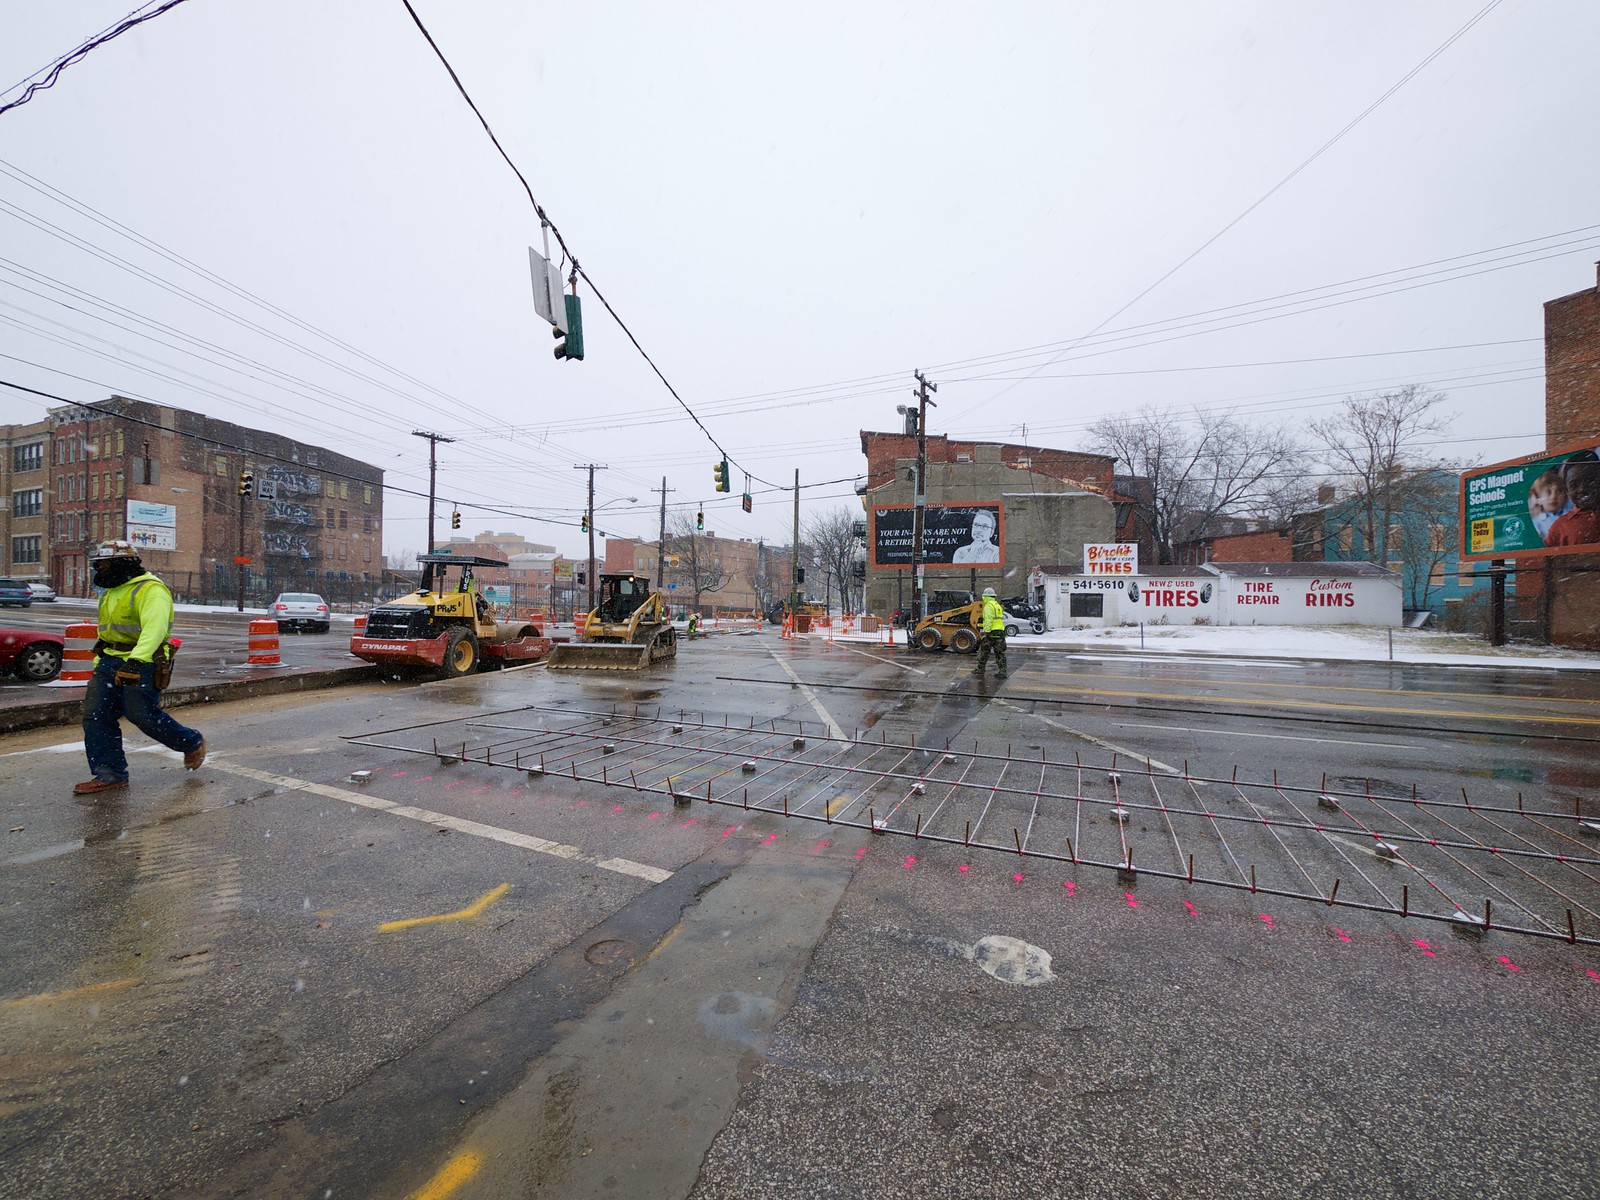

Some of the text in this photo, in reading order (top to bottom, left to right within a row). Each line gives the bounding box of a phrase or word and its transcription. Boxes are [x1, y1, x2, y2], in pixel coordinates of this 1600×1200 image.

[1469, 470, 1524, 492] CPS Magnet
[1469, 488, 1506, 505] Schools
[1473, 521, 1488, 529] Apply
[880, 529, 900, 537] YOUR
[901, 528, 932, 536] IN-WS
[933, 528, 950, 536] ARE
[884, 538, 935, 546] RETIRENT
[1088, 544, 1132, 562] Birch's
[1088, 562, 1132, 574] TIRES
[1244, 582, 1274, 592] TIRE
[1310, 578, 1353, 591] Custom
[1141, 590, 1199, 607] TIRES
[1237, 595, 1280, 605] REPAIR
[1305, 593, 1355, 607] RIMS
[361, 643, 408, 651] DYNAPAC
